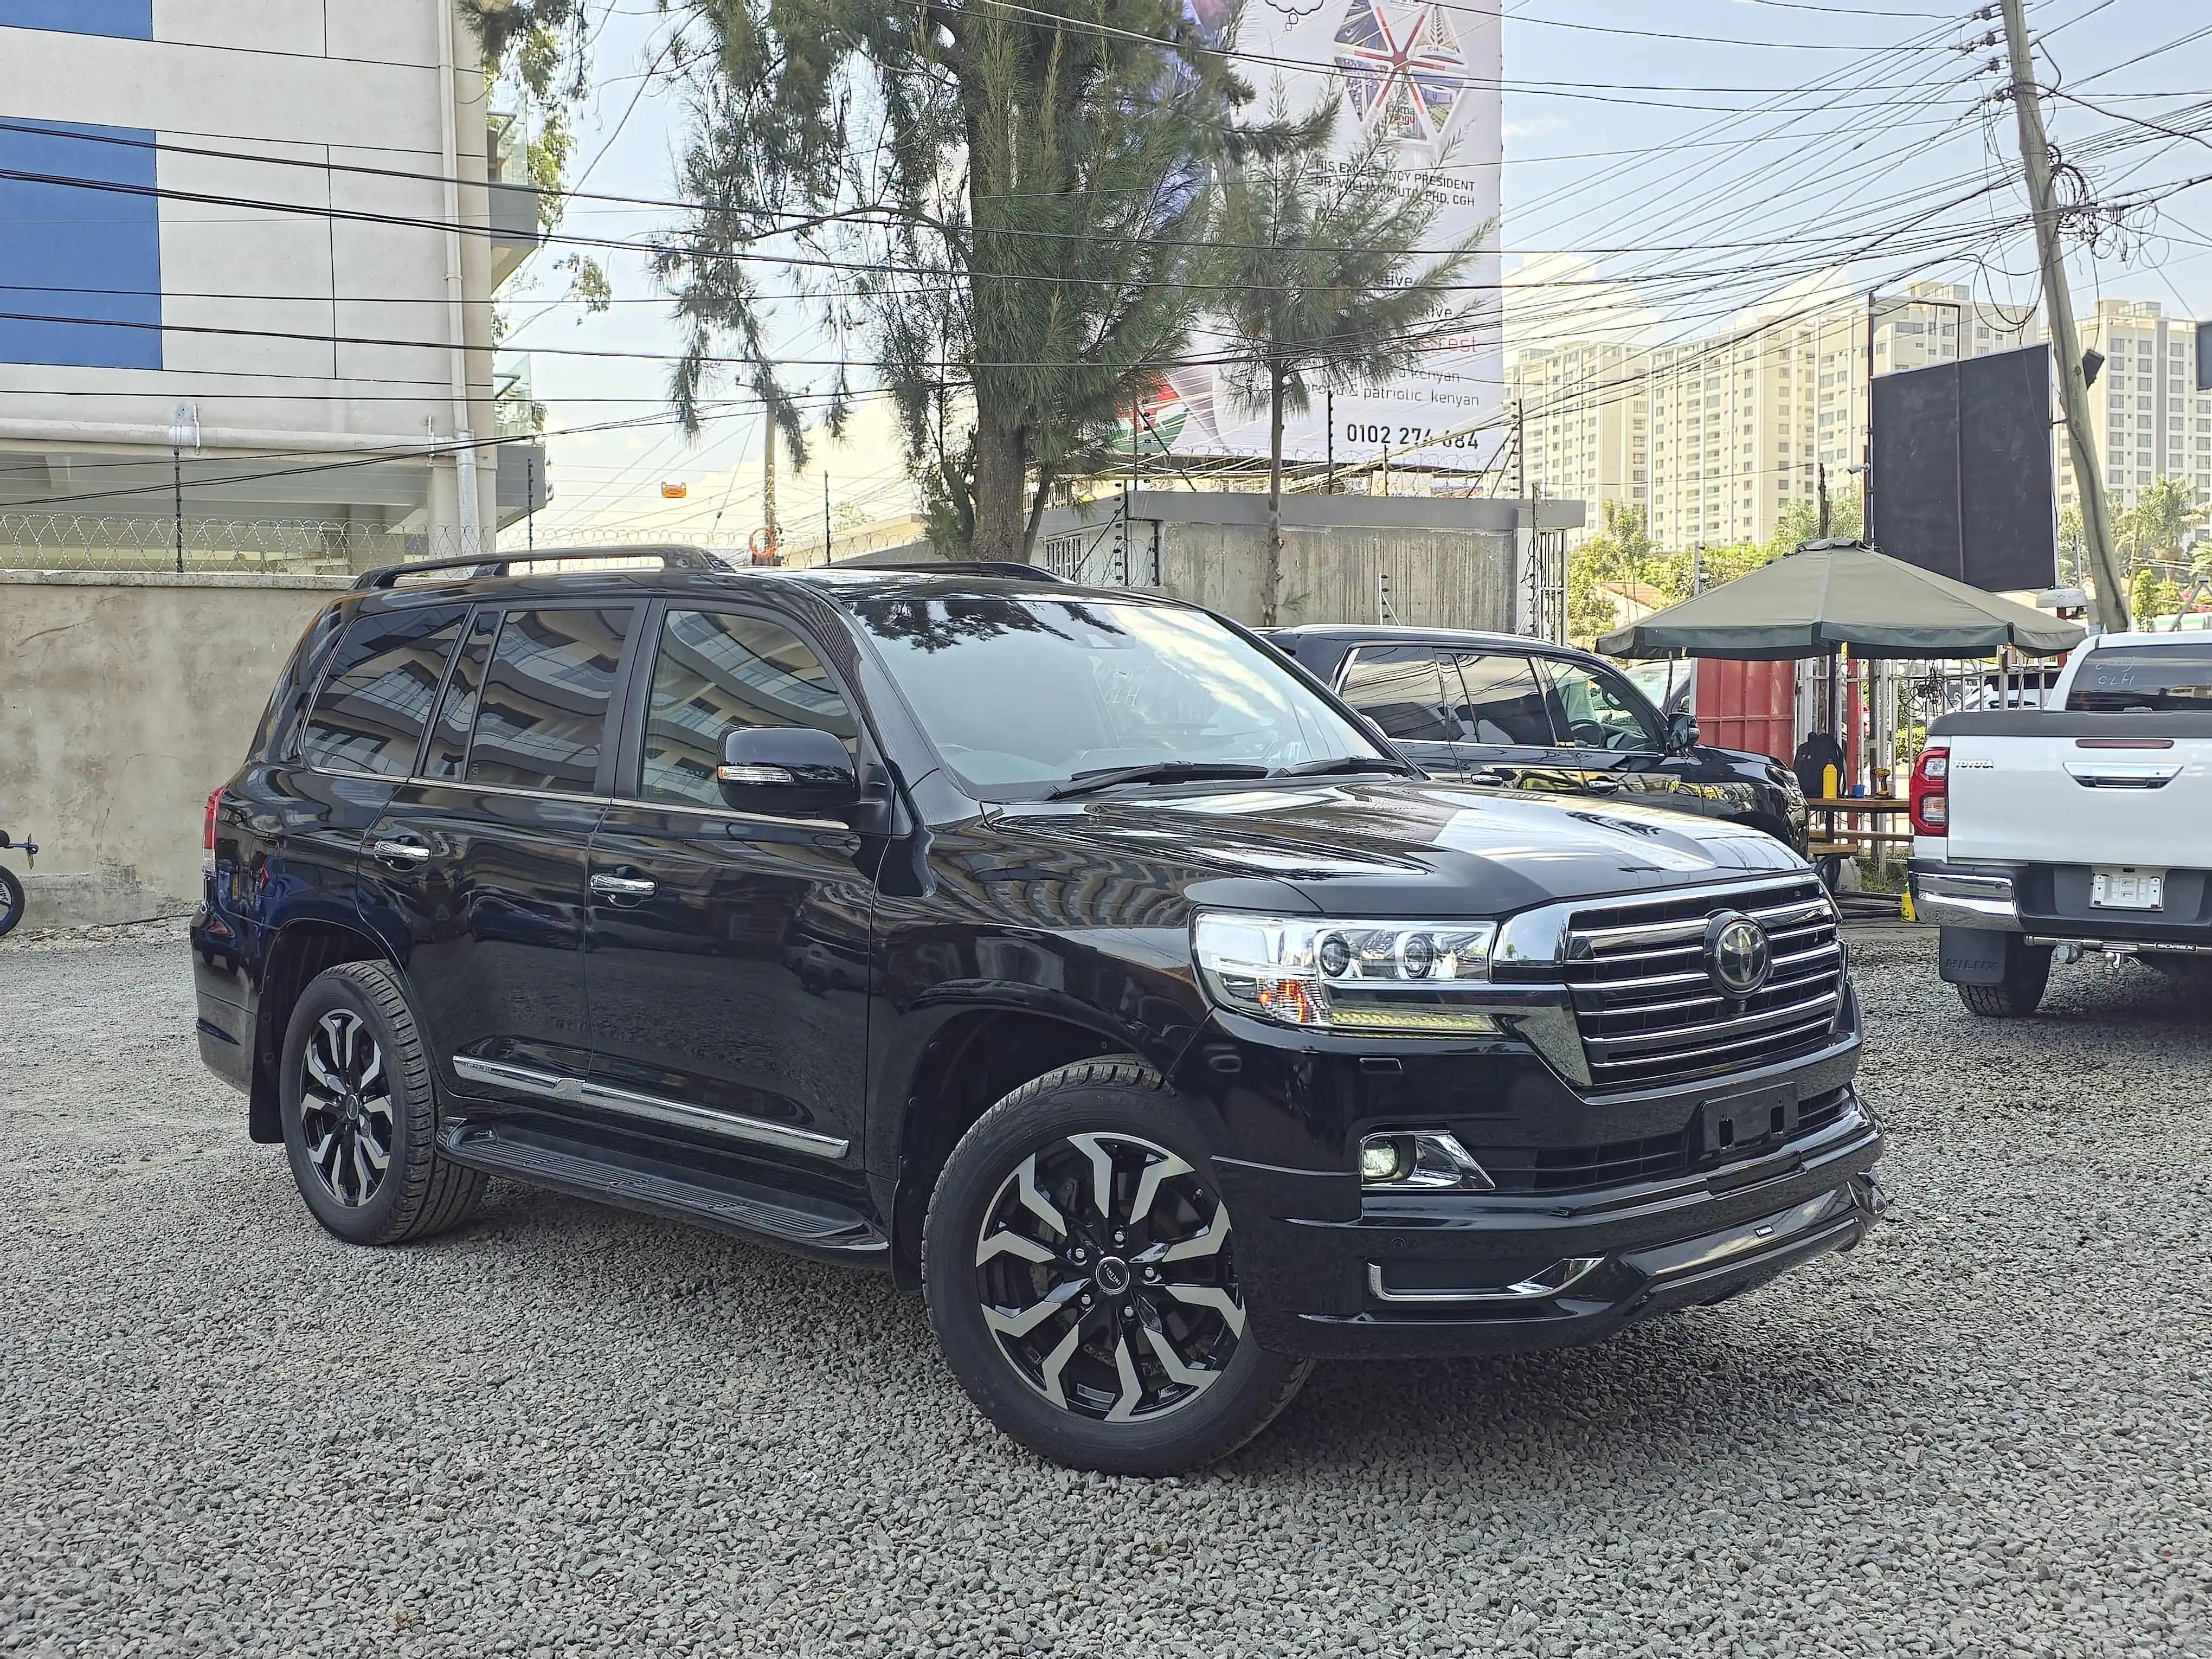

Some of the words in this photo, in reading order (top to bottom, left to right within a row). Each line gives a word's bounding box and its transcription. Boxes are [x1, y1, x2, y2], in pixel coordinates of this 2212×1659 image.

[1415, 173, 1475, 191] PRESIDENT
[1425, 190, 1449, 204] PHD,
[1453, 195, 1474, 207] CGH
[1364, 387, 1422, 401] patriotic
[1431, 389, 1479, 408] kenyan
[1347, 423, 1391, 443] 0102
[2098, 673, 2135, 685] CLH
[1953, 759, 1994, 769] TOYOTA
[1945, 959, 1999, 971] HILUX
